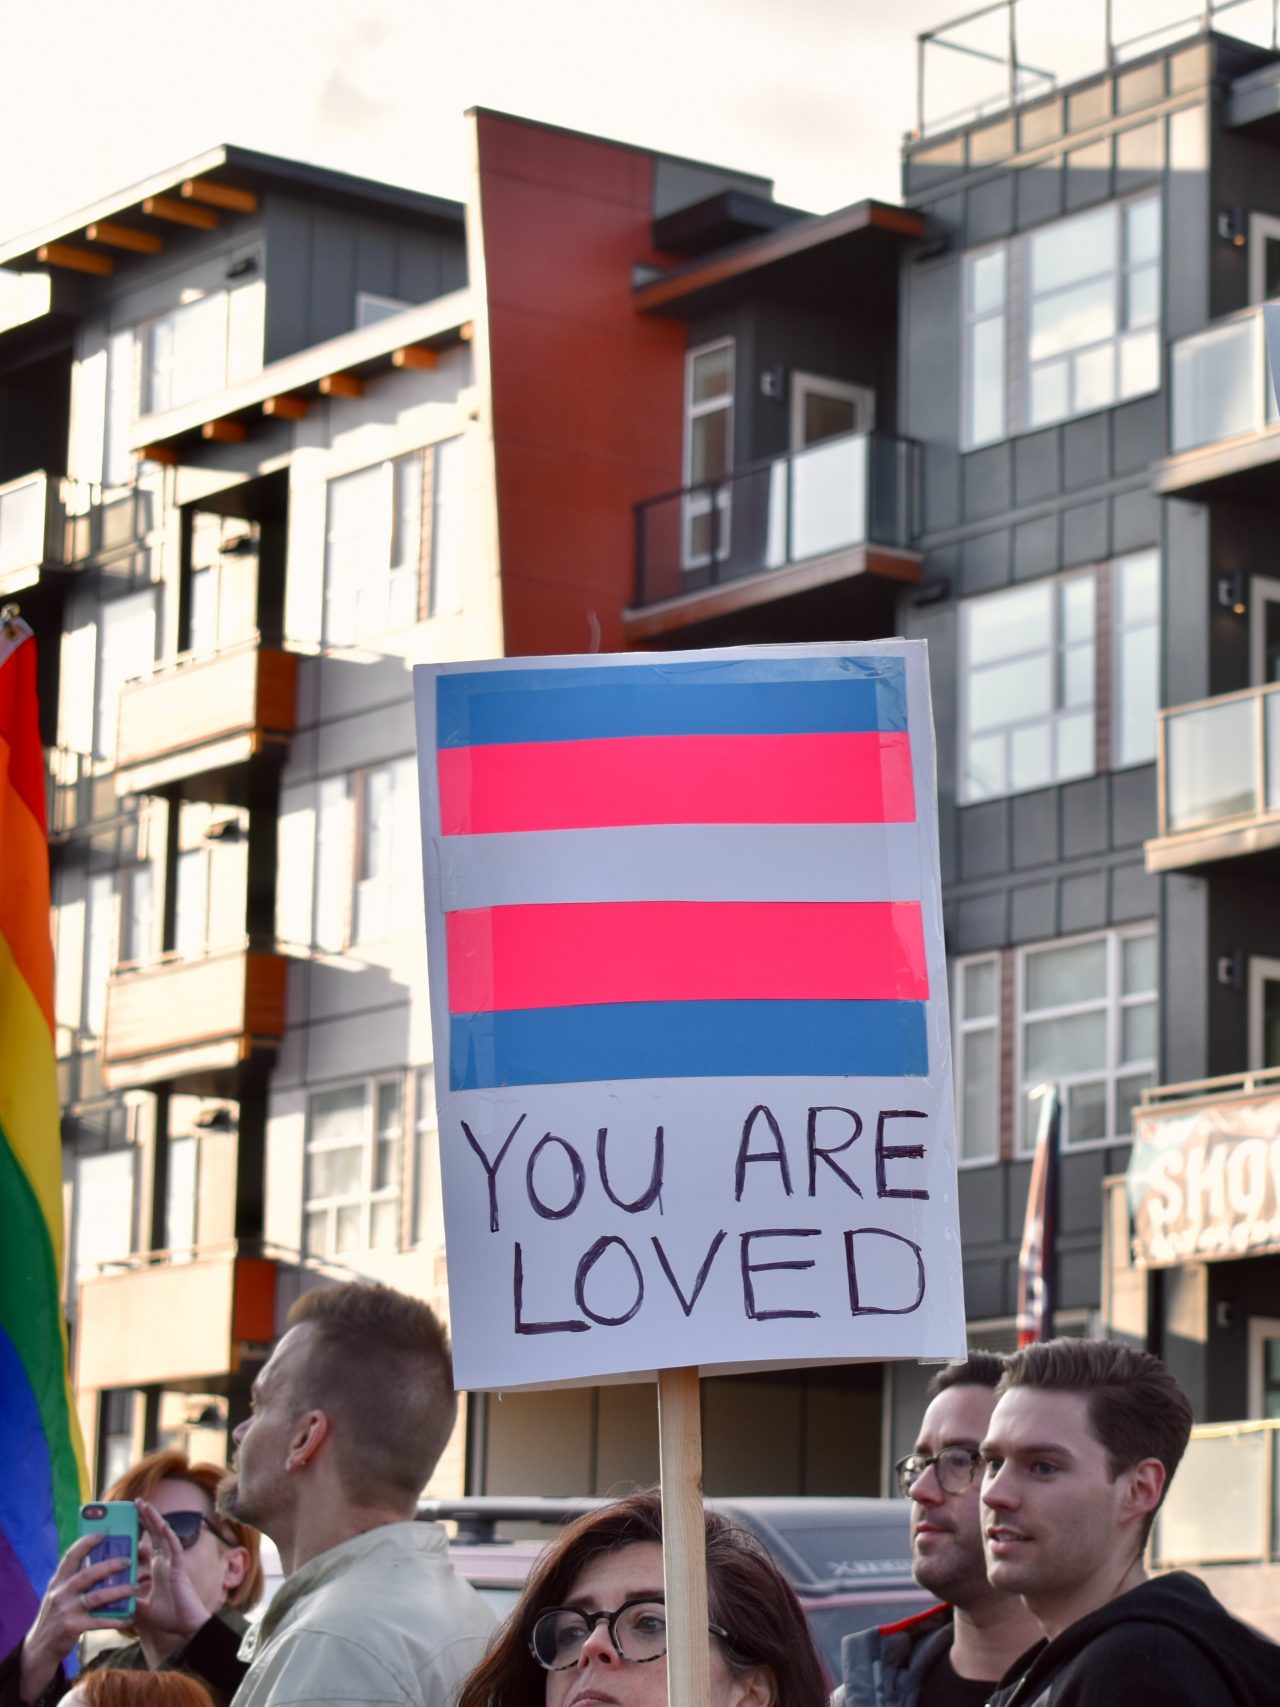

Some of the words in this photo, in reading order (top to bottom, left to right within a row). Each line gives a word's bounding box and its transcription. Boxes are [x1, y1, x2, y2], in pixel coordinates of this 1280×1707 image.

[460, 1112, 664, 1233] YOU
[734, 1103, 930, 1202] ARE
[513, 1227, 926, 1335] LOVED
